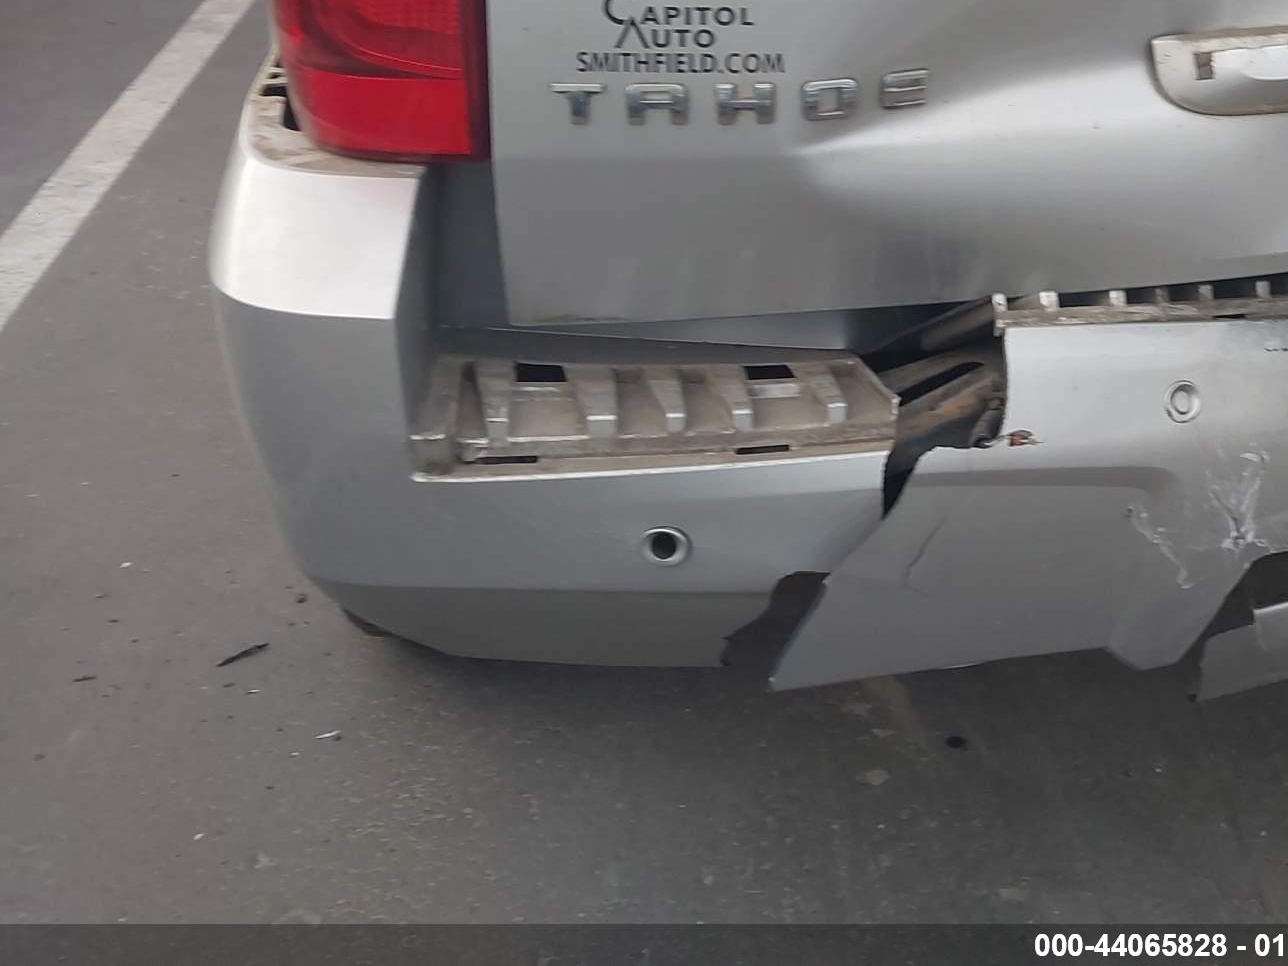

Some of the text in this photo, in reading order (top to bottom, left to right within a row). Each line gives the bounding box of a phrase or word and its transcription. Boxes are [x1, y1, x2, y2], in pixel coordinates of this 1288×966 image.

[613, 18, 717, 49] AUTO
[576, 51, 786, 74] SMITHFIELD.COM
[548, 68, 930, 126] TAHOE
